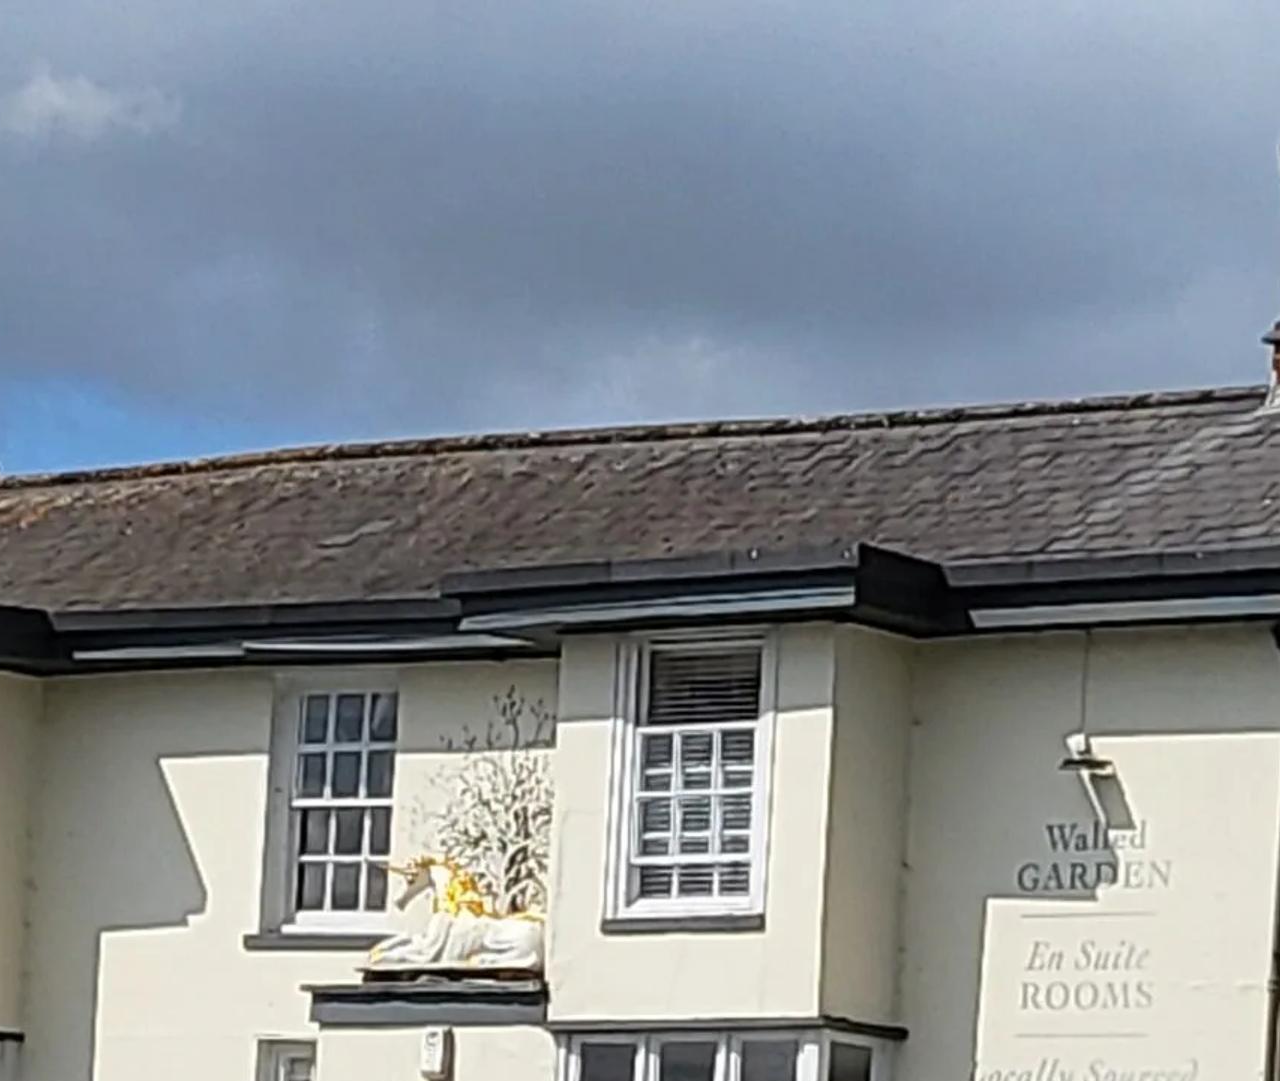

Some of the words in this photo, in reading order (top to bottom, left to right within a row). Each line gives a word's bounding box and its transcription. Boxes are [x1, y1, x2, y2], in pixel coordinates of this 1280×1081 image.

[1046, 820, 1146, 851] Walled
[1017, 860, 1172, 892] GARDEN
[1026, 941, 1064, 971] En
[1074, 940, 1150, 971] Suite
[1020, 981, 1155, 1010] ROOMS
